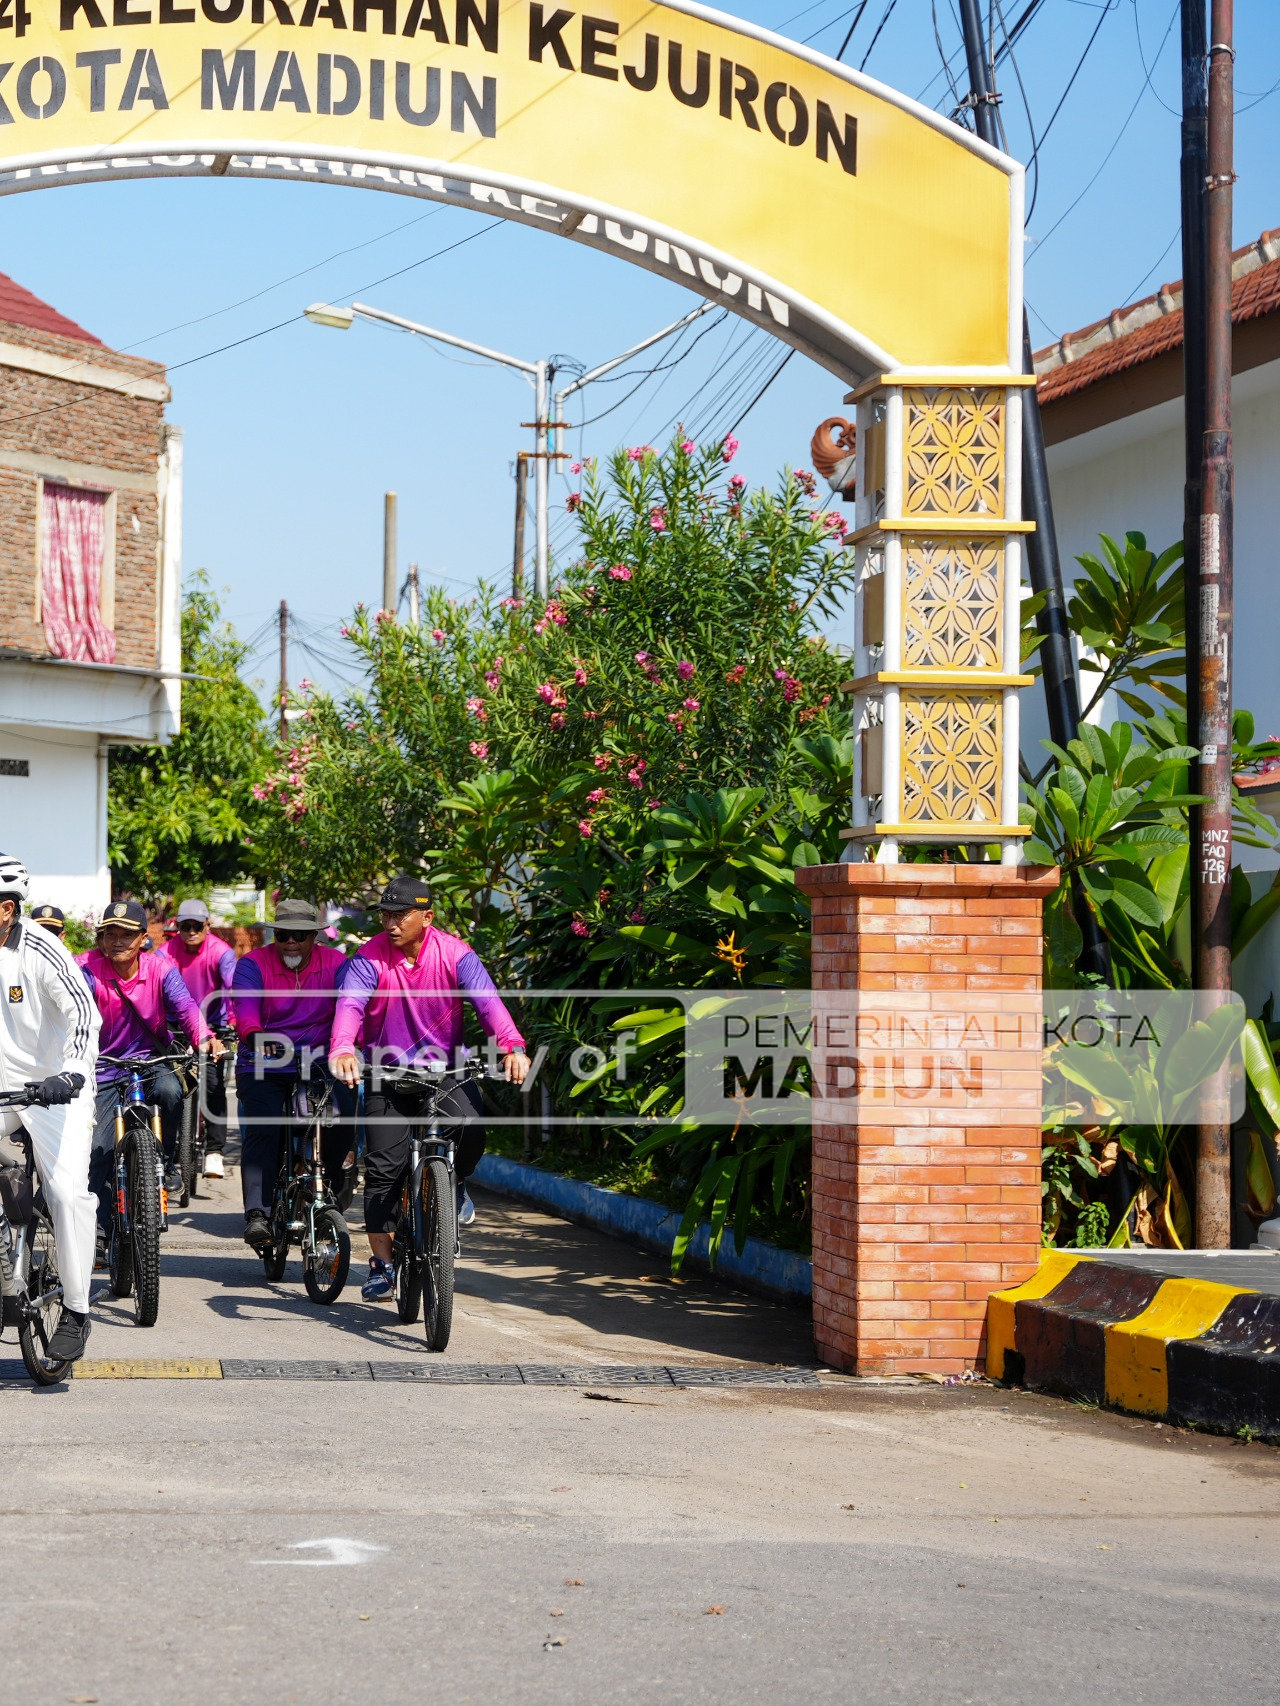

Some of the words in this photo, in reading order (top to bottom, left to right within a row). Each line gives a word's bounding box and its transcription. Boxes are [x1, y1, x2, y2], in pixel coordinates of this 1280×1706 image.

[201, 48, 497, 138] MADIUN
[529, 1, 858, 177] KEJURON
[1202, 829, 1229, 843] MNZ
[1203, 859, 1225, 873] 126
